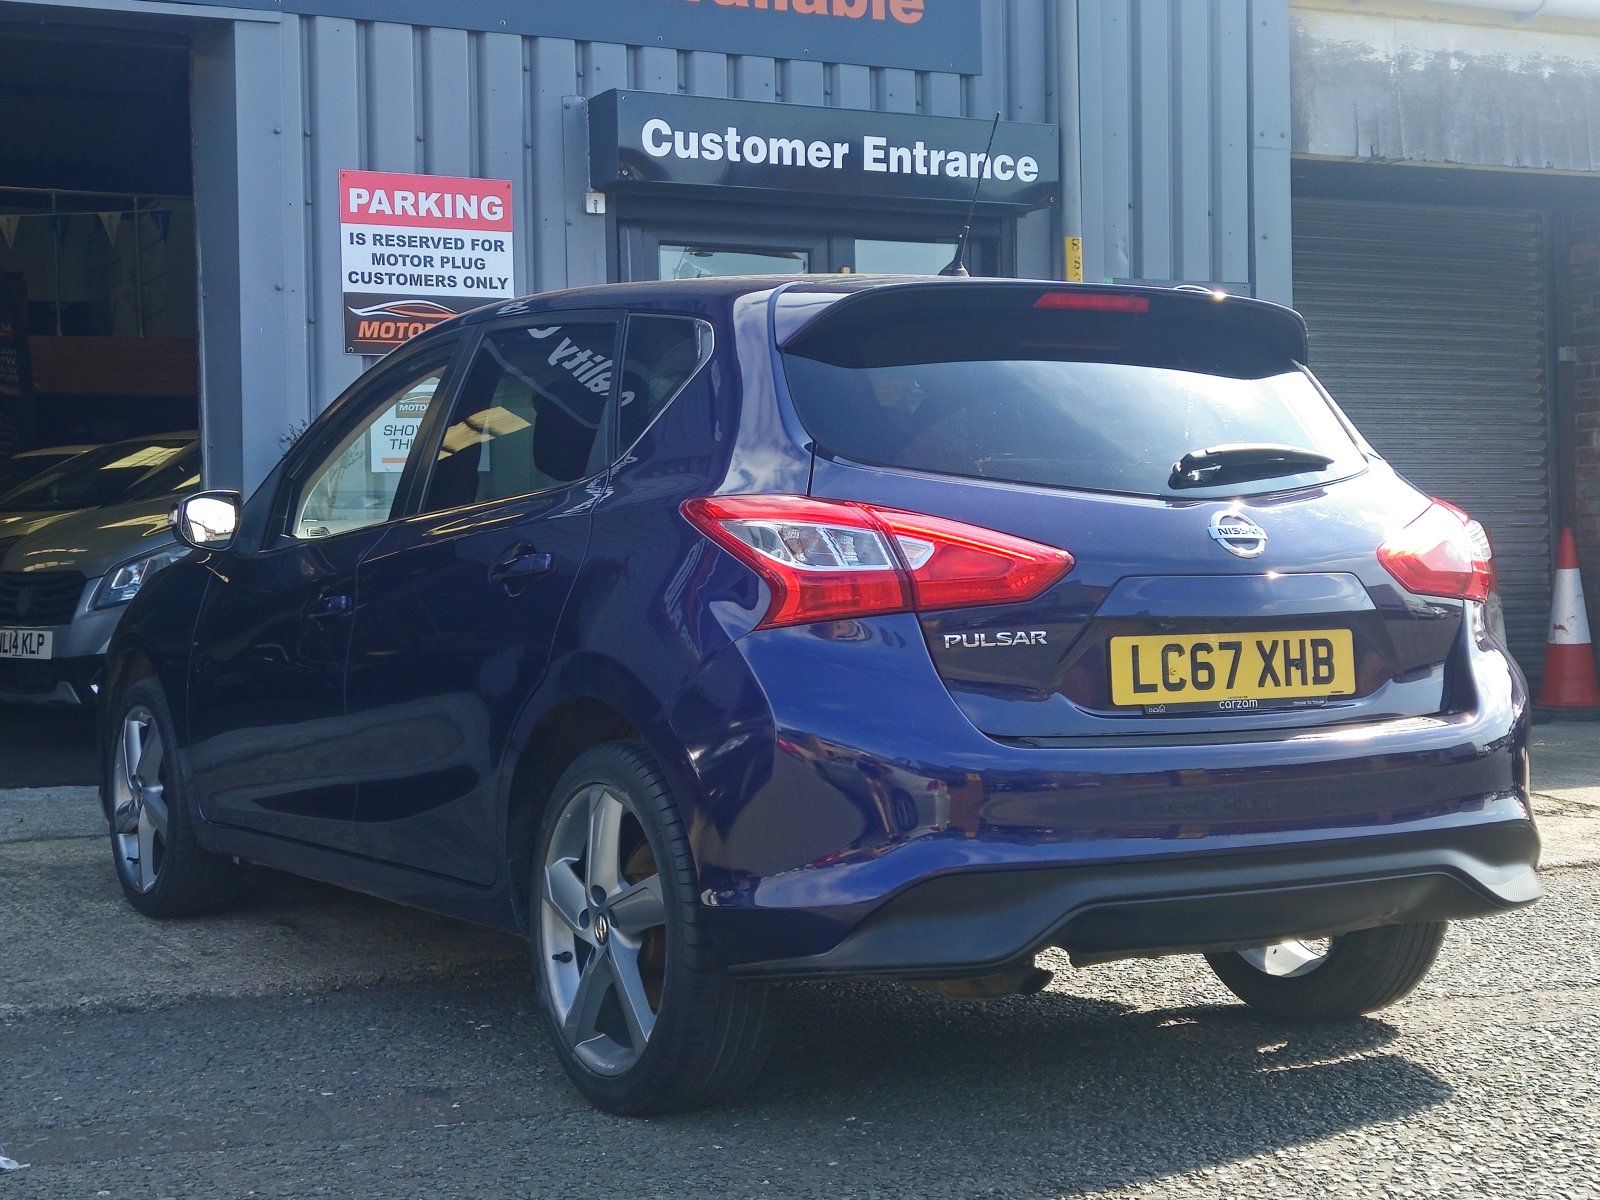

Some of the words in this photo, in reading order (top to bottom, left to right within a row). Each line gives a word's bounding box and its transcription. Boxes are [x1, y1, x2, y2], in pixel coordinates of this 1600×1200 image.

[641, 118, 850, 171] Customer
[862, 136, 1040, 183] Entrance
[349, 187, 504, 221] PARKING
[349, 232, 366, 246] IS
[372, 233, 465, 251] RESERVED
[471, 238, 506, 253] FOR
[371, 253, 434, 268] MOTOR
[440, 256, 486, 270] PLUG
[348, 271, 457, 288] CUSTOMERS
[463, 276, 509, 290] ONLY
[399, 404, 429, 412] MOTO
[383, 424, 420, 436] SHO
[1217, 527, 1263, 536] NISSAN
[21, 632, 45, 655] KLP
[943, 630, 1048, 649] PULSAR
[1131, 641, 1243, 694] LC67
[1255, 638, 1336, 688] XHB
[1219, 698, 1258, 709] carzam
